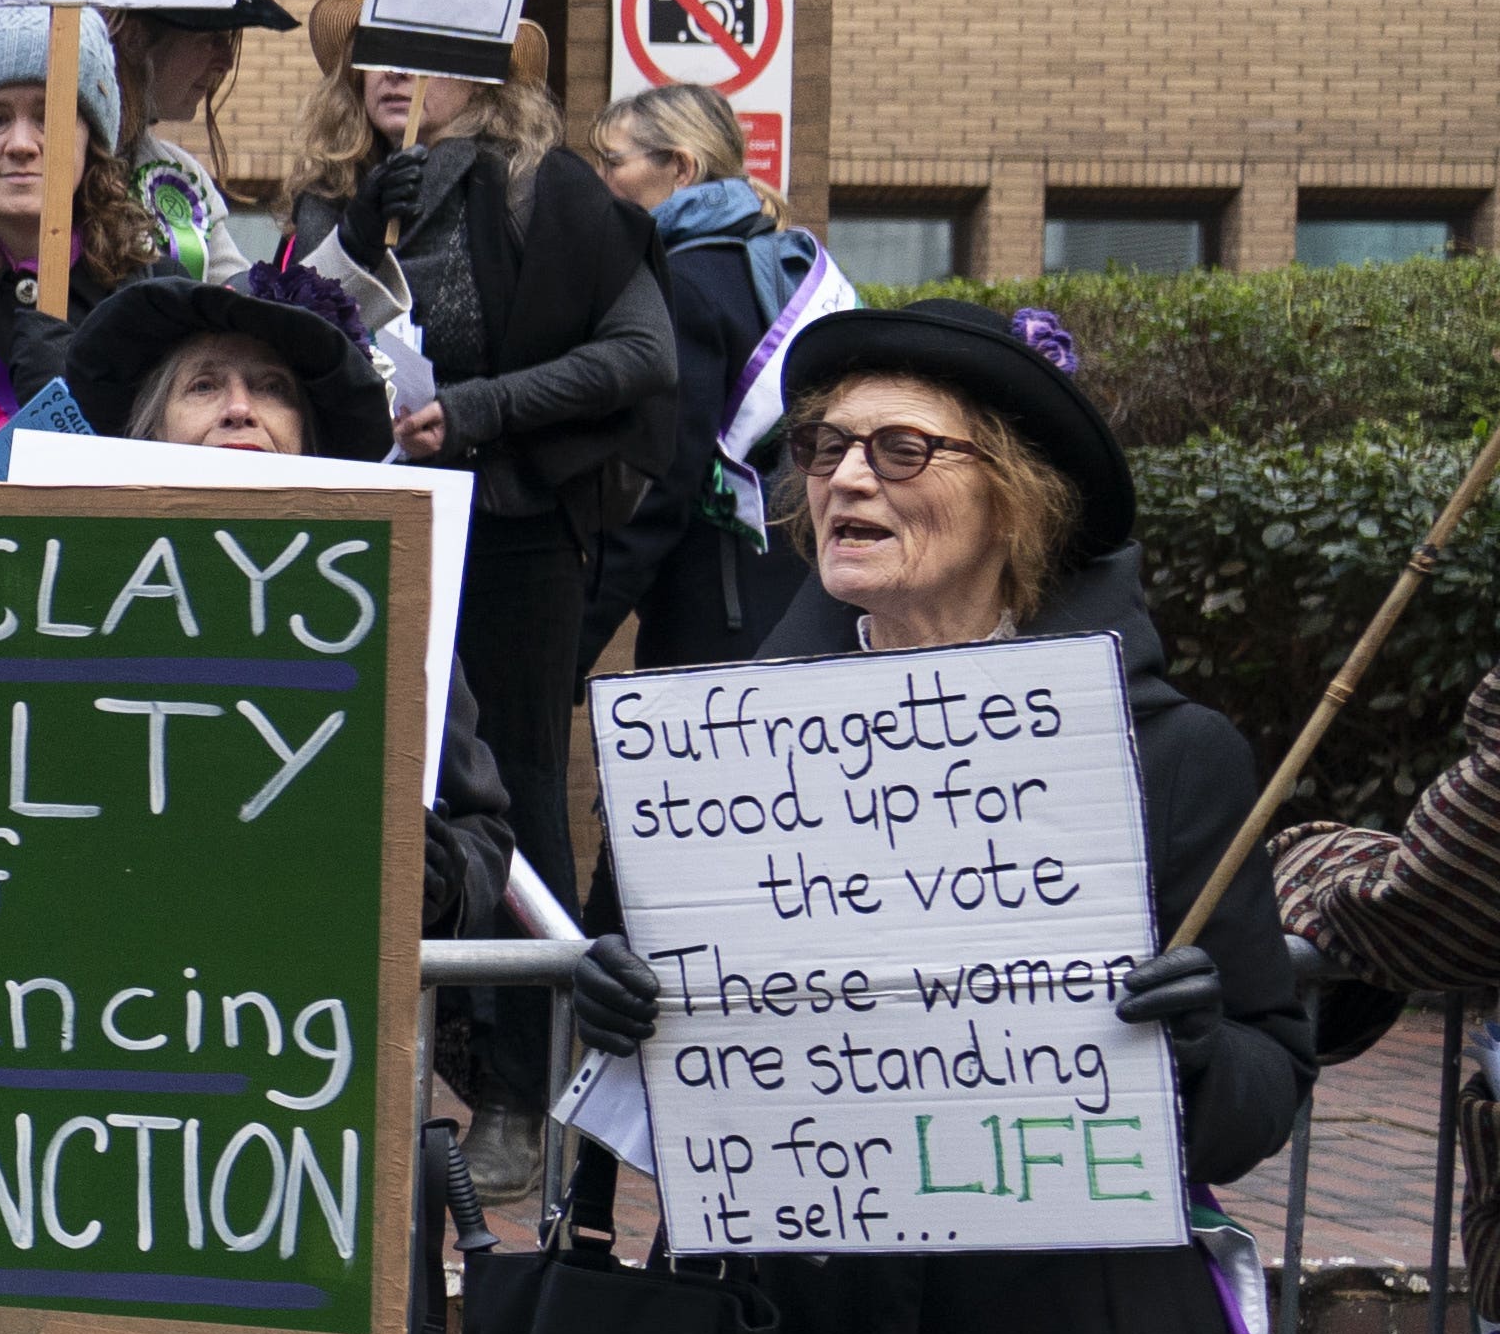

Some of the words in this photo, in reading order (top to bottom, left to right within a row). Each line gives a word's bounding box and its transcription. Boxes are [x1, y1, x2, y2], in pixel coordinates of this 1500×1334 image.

[611, 671, 1062, 778] Suffragettes
[631, 747, 824, 840] stood
[845, 782, 919, 850] up
[932, 760, 1048, 829] for
[759, 852, 882, 921] the
[905, 839, 1081, 912] vote
[650, 944, 880, 1019] These
[913, 952, 1138, 1014] women
[675, 1044, 785, 1091] are
[808, 1019, 1111, 1114] standing
[686, 1132, 754, 1199] up
[772, 1117, 893, 1181] for
[915, 1114, 1154, 1203] LIFE
[702, 1187, 753, 1245] it
